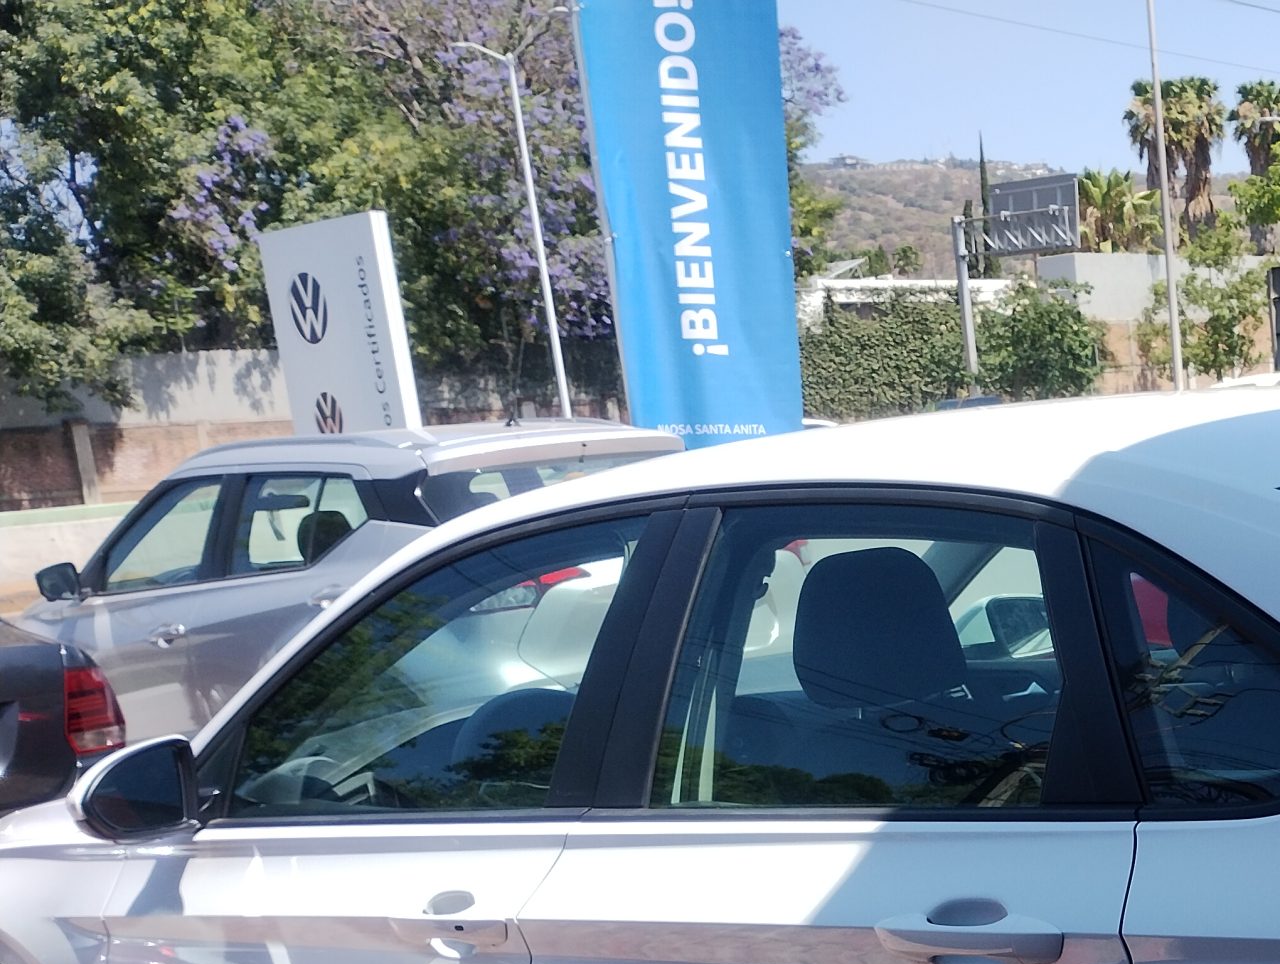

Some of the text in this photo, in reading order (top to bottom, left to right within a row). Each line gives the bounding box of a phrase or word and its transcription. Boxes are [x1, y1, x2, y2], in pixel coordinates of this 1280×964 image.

[356, 256, 386, 394] Certificados
[695, 423, 732, 435] SANTA
[733, 423, 767, 435] ANITA
